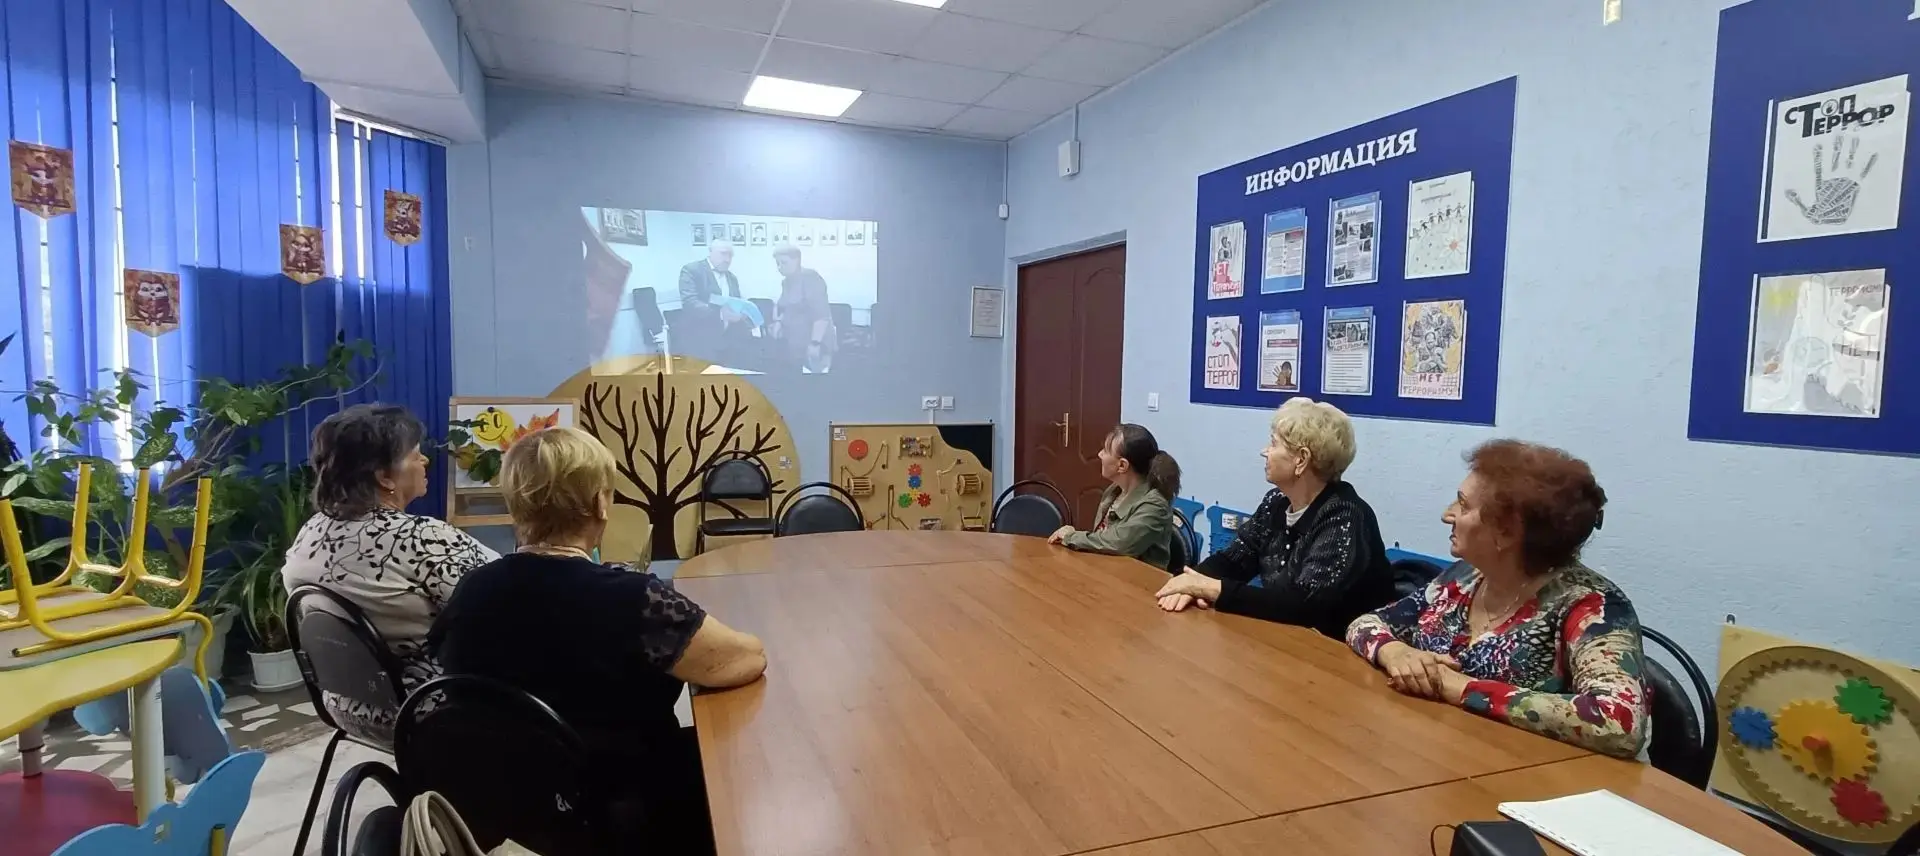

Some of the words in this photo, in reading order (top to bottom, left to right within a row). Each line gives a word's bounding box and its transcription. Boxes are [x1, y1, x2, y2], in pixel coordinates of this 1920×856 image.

[1245, 128, 1418, 196] ИНФОРМАЦИЯ
[1207, 353, 1230, 368] СТОП
[1419, 373, 1442, 382] НЕТ
